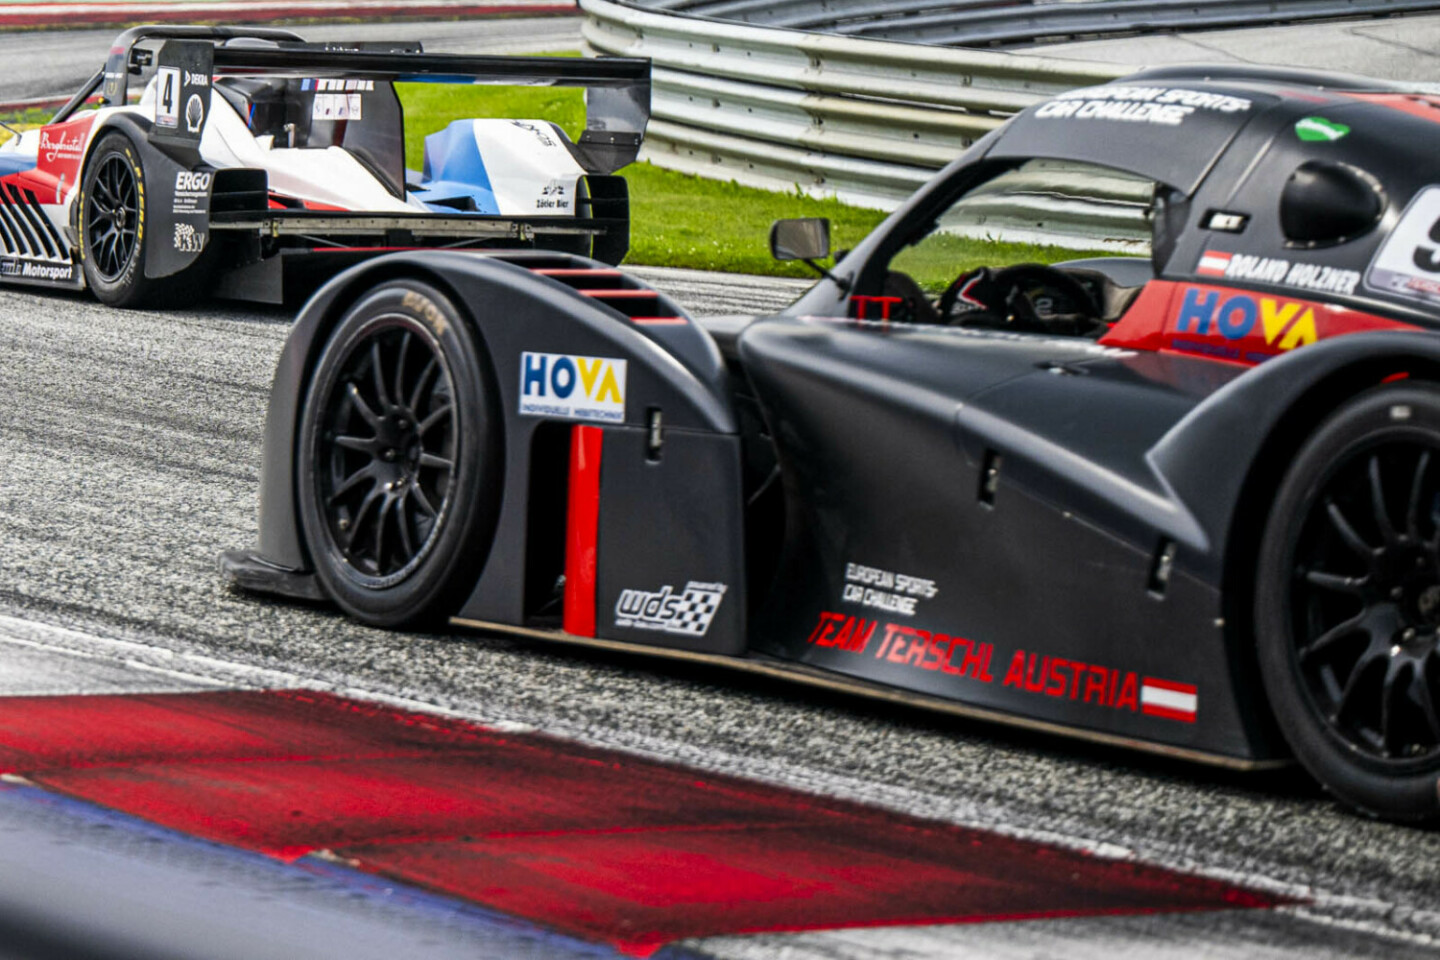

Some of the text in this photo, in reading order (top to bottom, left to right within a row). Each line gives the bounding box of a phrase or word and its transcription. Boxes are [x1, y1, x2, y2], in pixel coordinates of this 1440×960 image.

[162, 73, 173, 114] 4
[175, 172, 210, 190] ERGO
[22, 262, 72, 279] Motorsport
[1225, 253, 1290, 283] ROLAND
[1285, 262, 1361, 296] HOLZNER
[1177, 288, 1318, 350] HOVA
[523, 354, 623, 404] HOVA
[846, 562, 895, 589] EUROPEAN
[617, 586, 681, 622] wds
[842, 583, 918, 617] CAR CHALLENGE
[807, 611, 1139, 713] TEAM TERSCHL AUSTRIA
